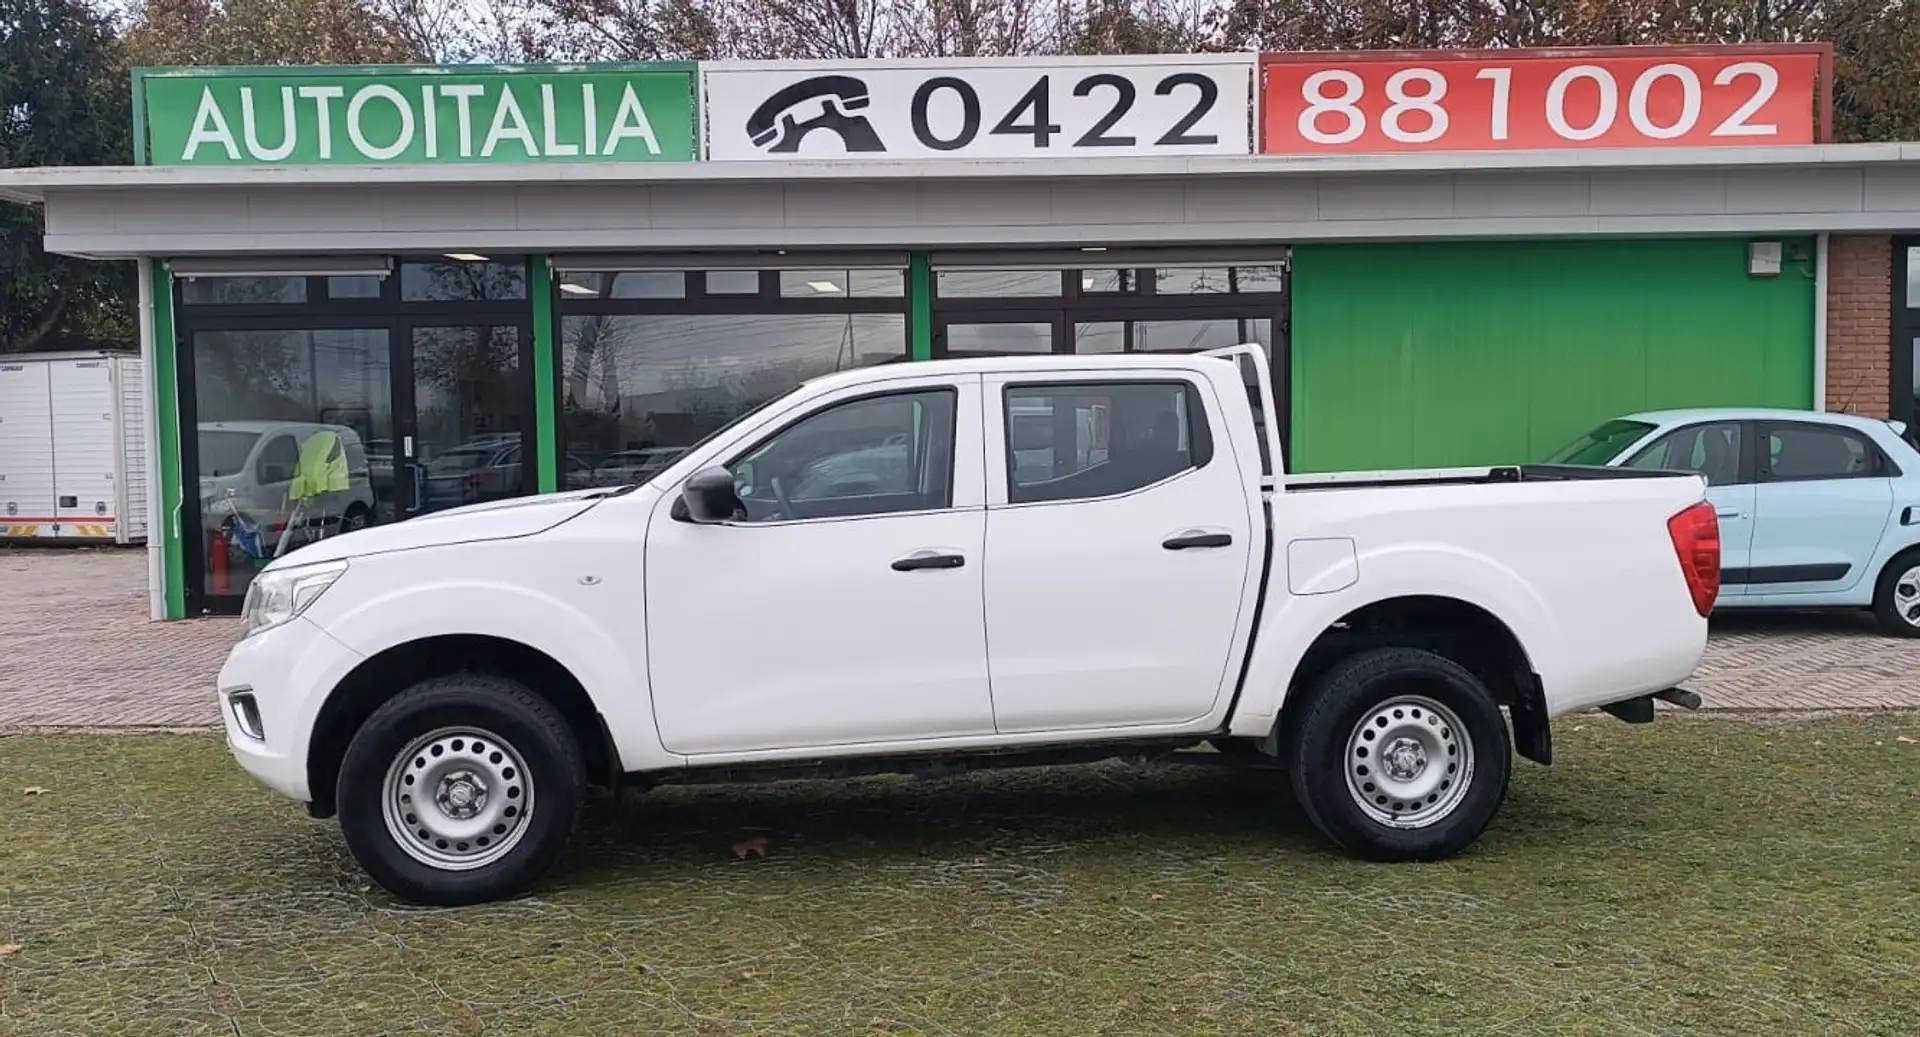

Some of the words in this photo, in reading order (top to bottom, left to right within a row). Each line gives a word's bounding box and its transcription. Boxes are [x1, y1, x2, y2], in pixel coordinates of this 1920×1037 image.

[181, 81, 662, 161] AUTOITALIA
[910, 72, 1219, 151] 0422
[1296, 62, 1779, 145] 881002
